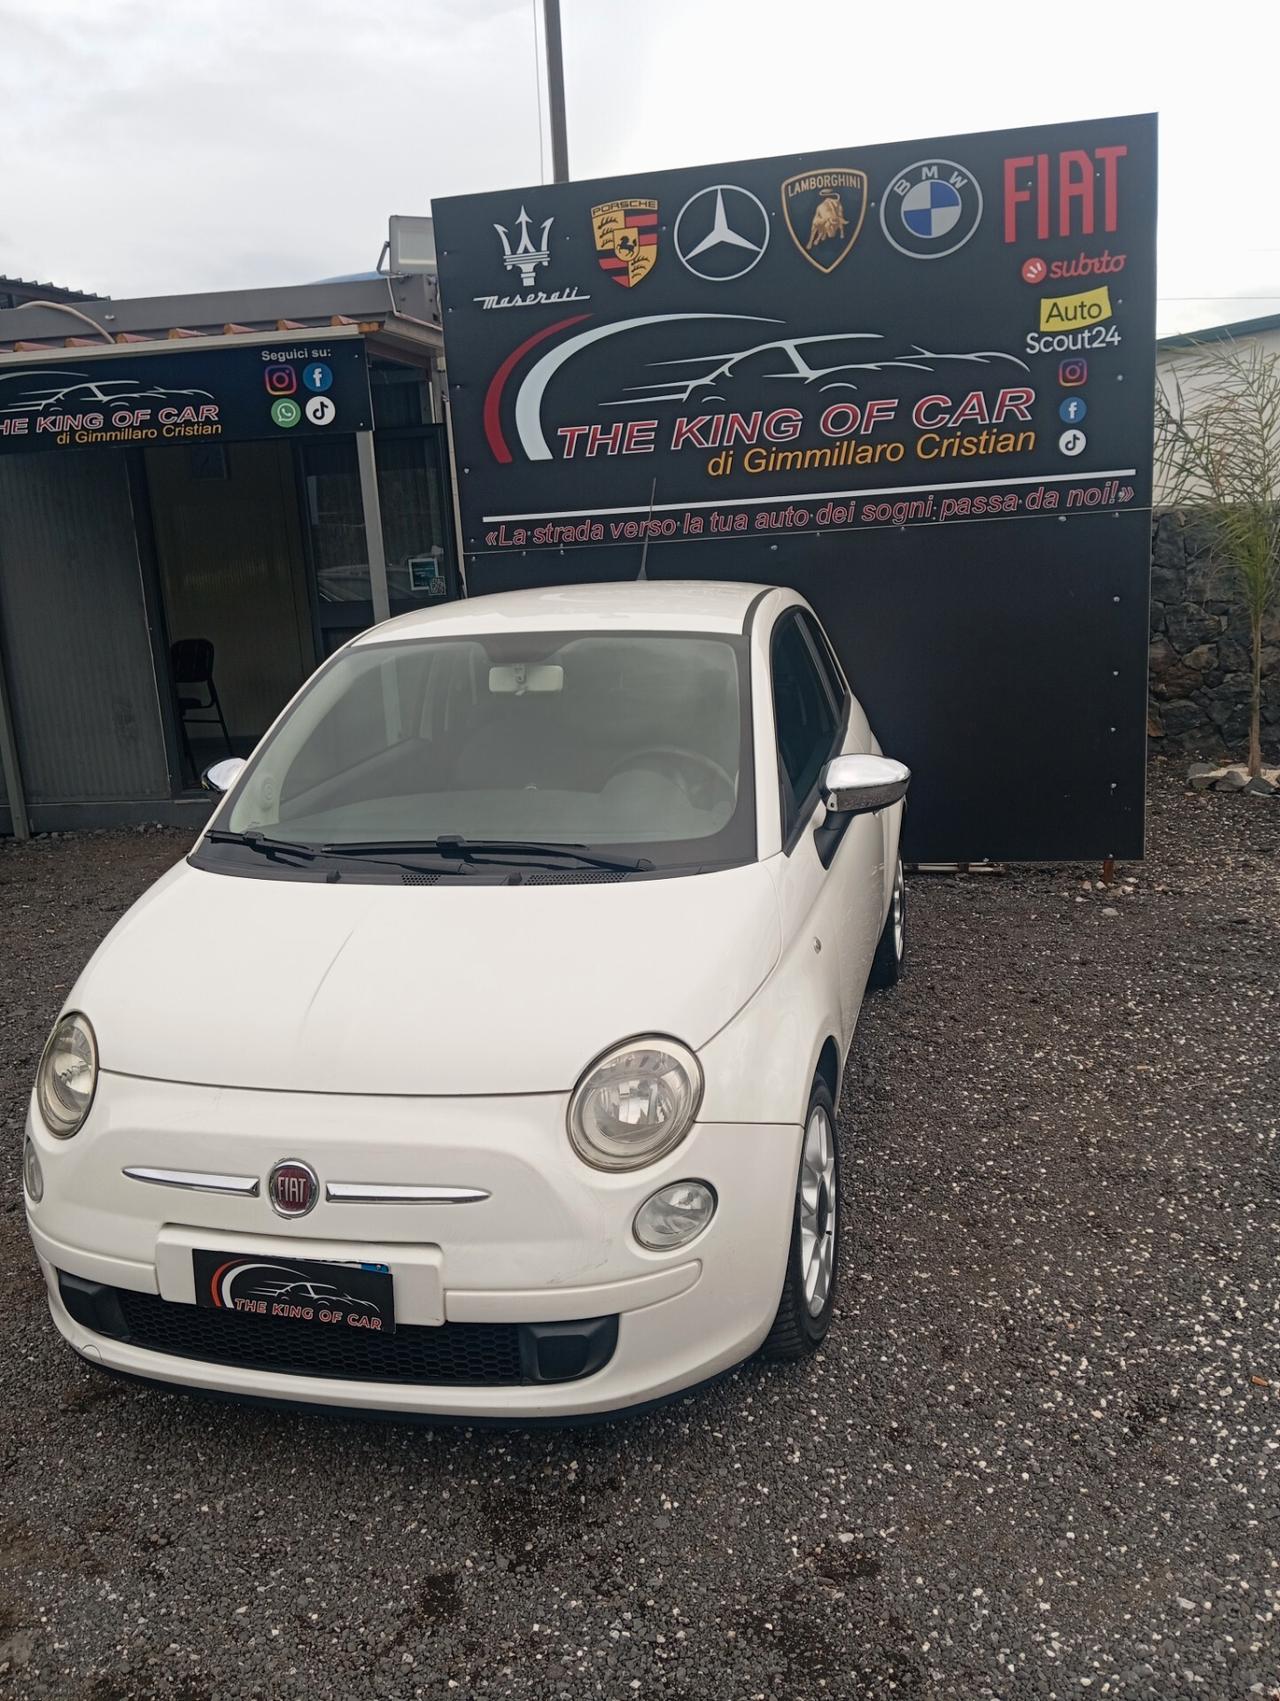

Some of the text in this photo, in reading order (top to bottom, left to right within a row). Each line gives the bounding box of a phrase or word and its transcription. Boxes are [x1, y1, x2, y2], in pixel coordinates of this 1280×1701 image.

[787, 172, 862, 198] LAMBORGHINI
[893, 165, 969, 198] BMW
[1003, 145, 1128, 243] FIAT
[592, 199, 657, 216] PORSCHE
[1049, 249, 1127, 279] subito
[1045, 301, 1103, 324] Auto
[1025, 324, 1122, 355] Scout24
[261, 348, 331, 362] Seguici su:
[36, 412, 104, 433] KING
[111, 408, 151, 428] OF
[158, 404, 219, 424] CAR
[56, 422, 222, 445] di Gimmillaro Cristian
[557, 387, 1036, 459] THE KING OF CAR
[707, 428, 1036, 477] di Gimmillaro Cristian
[532, 519, 604, 544] strada
[610, 518, 677, 539] verso
[682, 512, 704, 534] la
[709, 510, 749, 532] tua
[754, 505, 809, 529] auto
[816, 500, 855, 525] dei
[861, 495, 934, 525] sogni
[939, 493, 1019, 522] passa
[1025, 487, 1060, 510] da
[277, 1176, 307, 1203] FIAT
[234, 1297, 383, 1330] THE KING OF CAR
